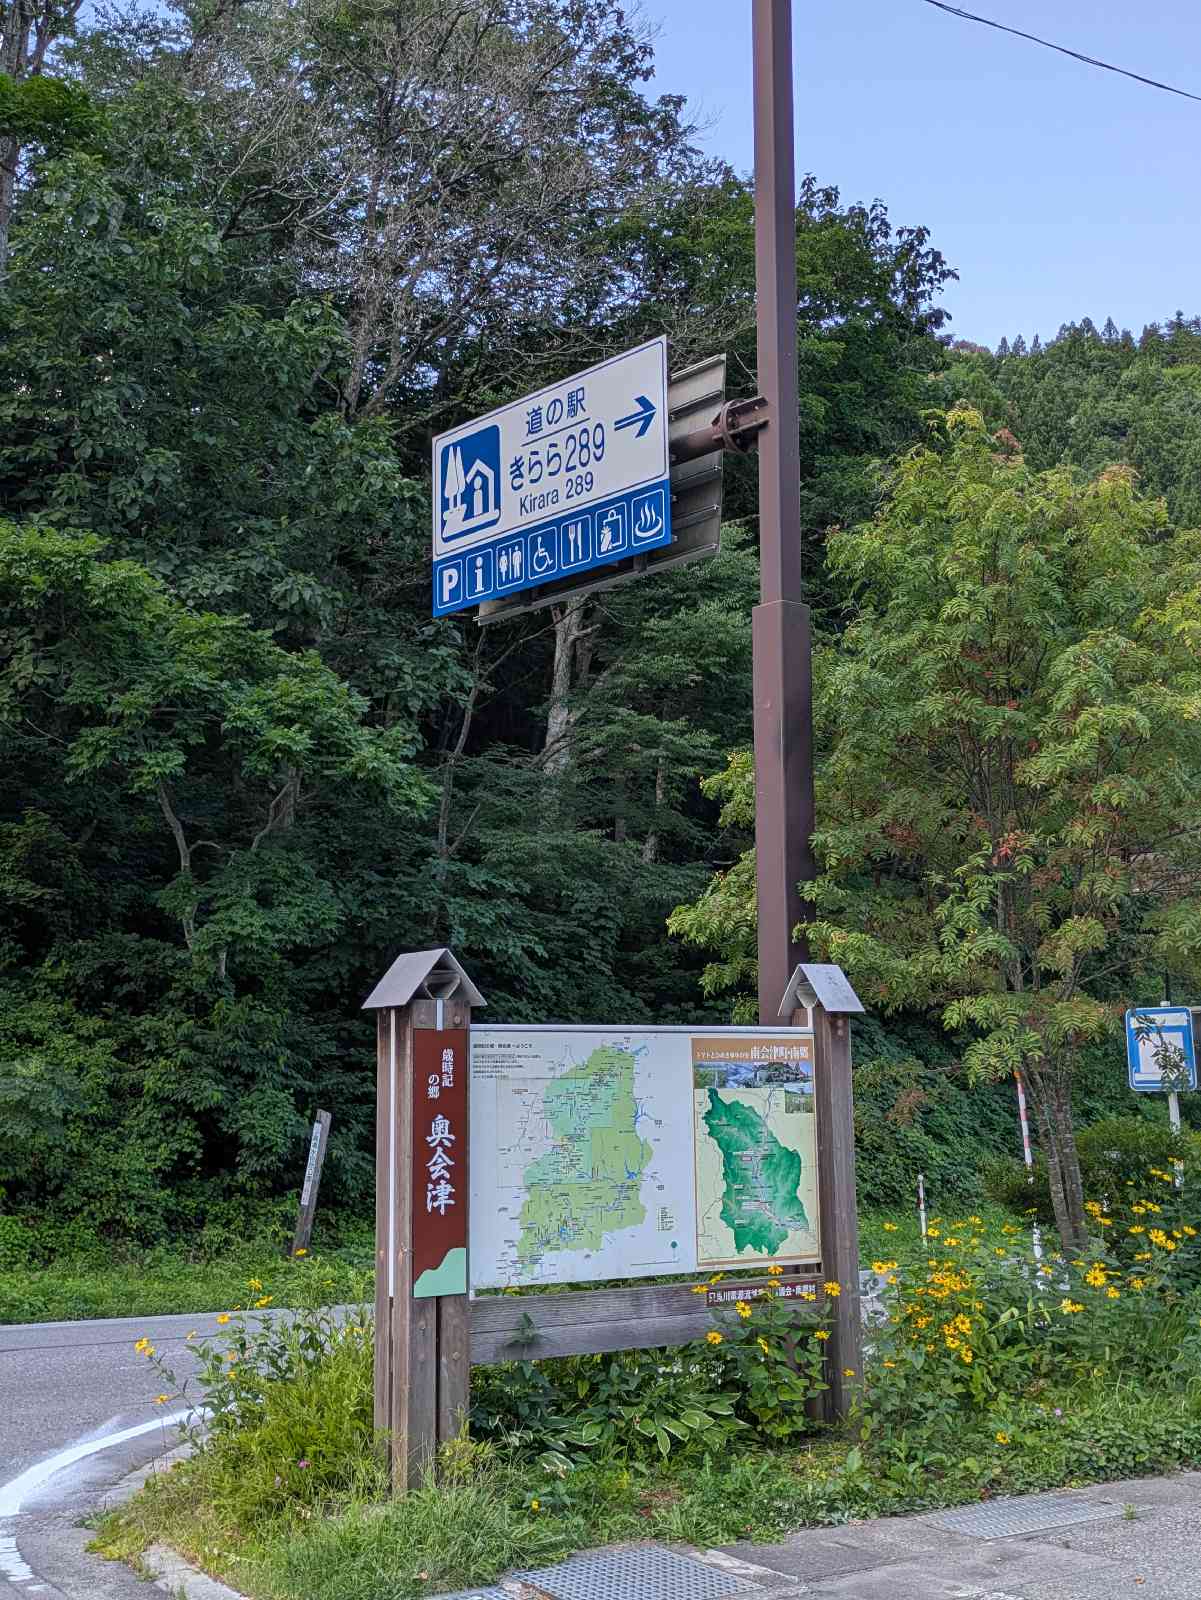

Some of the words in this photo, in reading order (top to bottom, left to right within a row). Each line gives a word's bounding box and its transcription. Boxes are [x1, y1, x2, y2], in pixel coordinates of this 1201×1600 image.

[525, 386, 587, 437] 道の駅
[509, 422, 606, 492] きらら289
[519, 488, 560, 517] Kirara
[565, 471, 594, 499] 289
[442, 568, 460, 602] P
[427, 1073, 440, 1099] の郷
[442, 1048, 454, 1088] 歳時記
[425, 1114, 456, 1216] 奥会津
